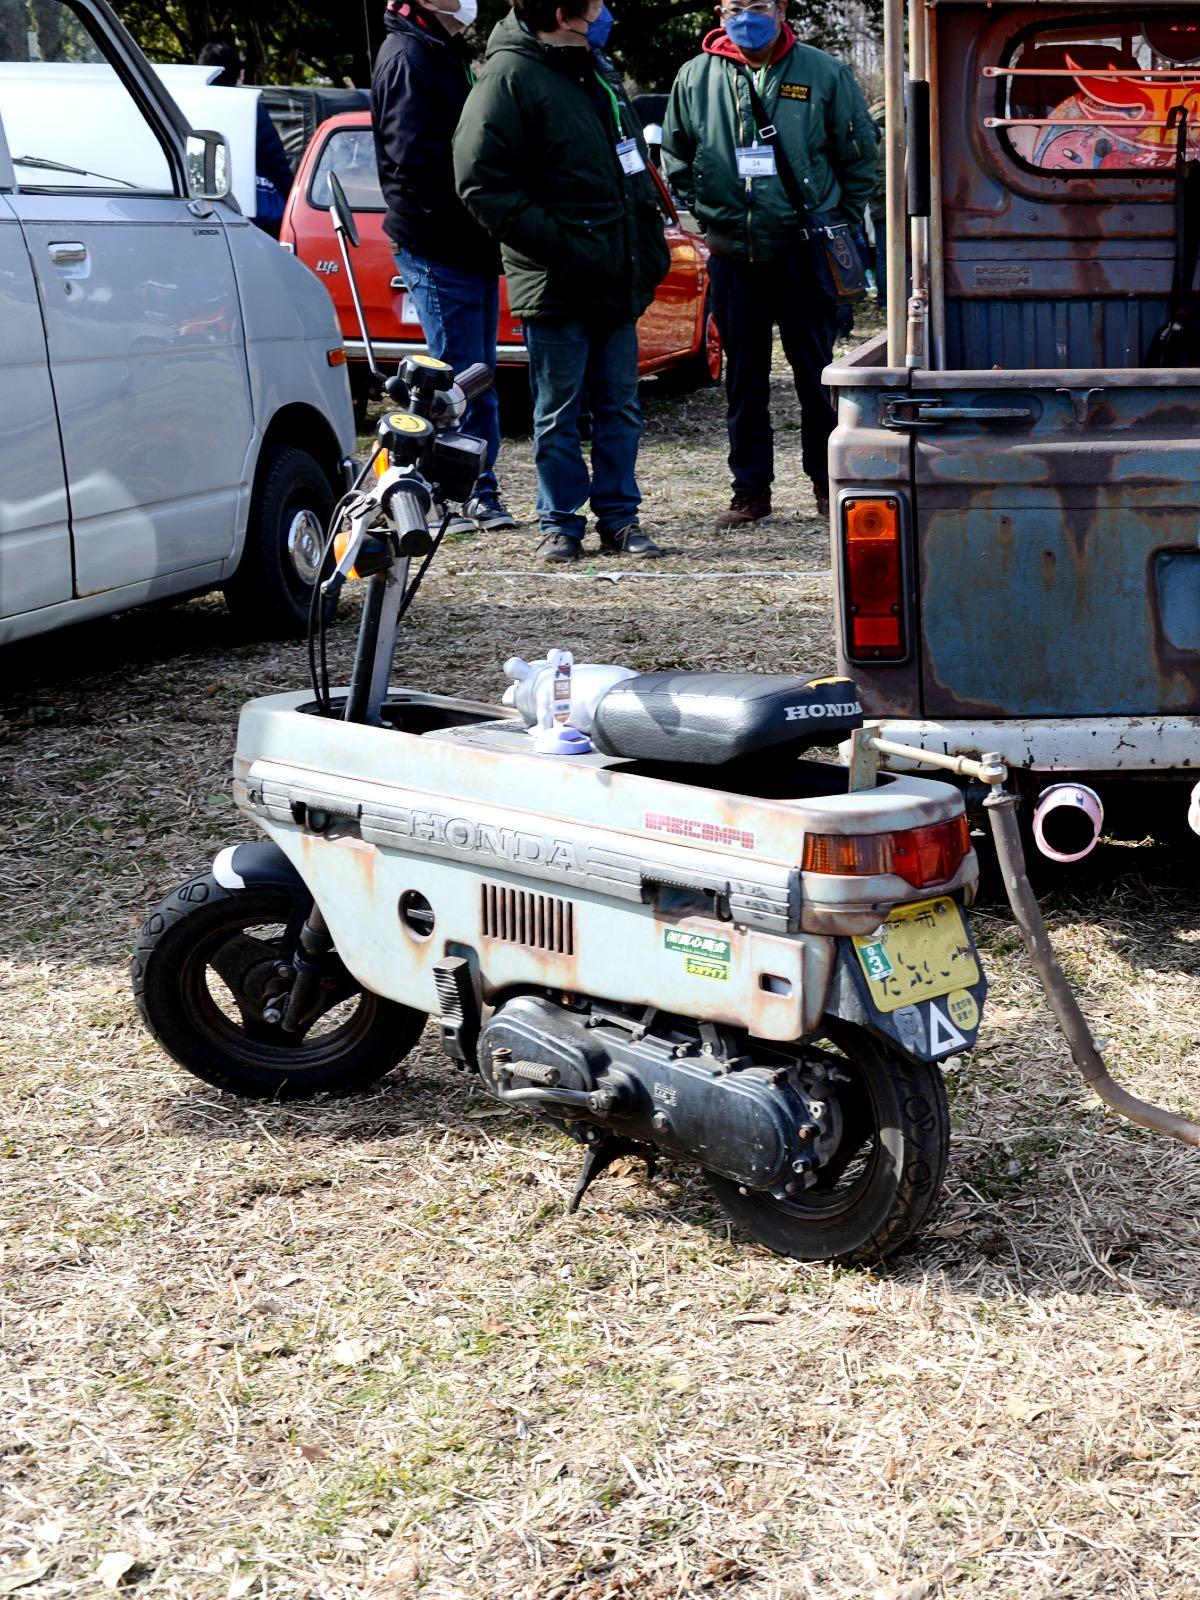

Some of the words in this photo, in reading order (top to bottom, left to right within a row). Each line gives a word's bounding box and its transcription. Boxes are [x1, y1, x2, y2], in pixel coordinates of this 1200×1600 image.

[316, 260, 339, 274] Life
[783, 701, 863, 720] HONDA
[409, 809, 585, 876] HONDA
[869, 955, 884, 974] 3
